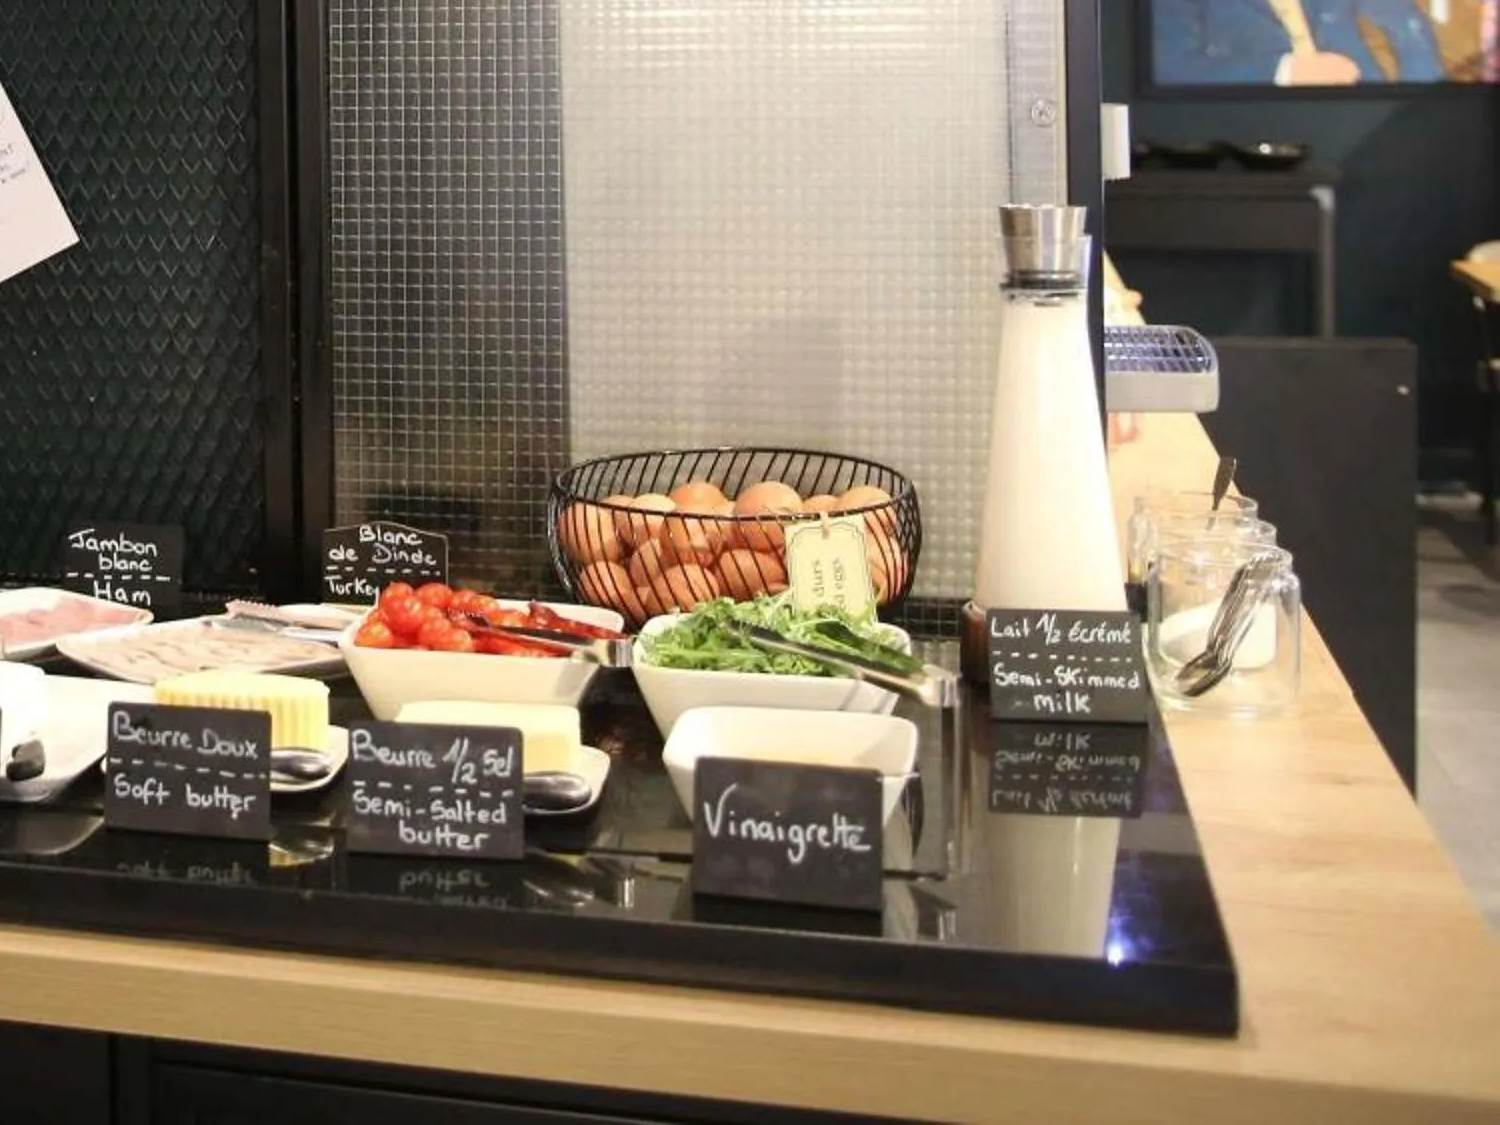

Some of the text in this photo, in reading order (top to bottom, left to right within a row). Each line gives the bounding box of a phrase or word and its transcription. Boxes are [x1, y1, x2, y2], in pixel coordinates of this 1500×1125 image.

[68, 528, 158, 557] Jambon
[359, 525, 422, 546] Blanc
[98, 552, 152, 572] blanc
[328, 542, 438, 566] de Dinde
[93, 580, 152, 605] Ham
[991, 616, 1030, 638] Lait
[1033, 691, 1091, 714] milk
[113, 710, 259, 760] Beurre Doux
[352, 729, 437, 769] Beurre
[114, 773, 257, 820] Soft butter
[399, 819, 490, 852] butter
[703, 782, 872, 864] Vinaigrette
